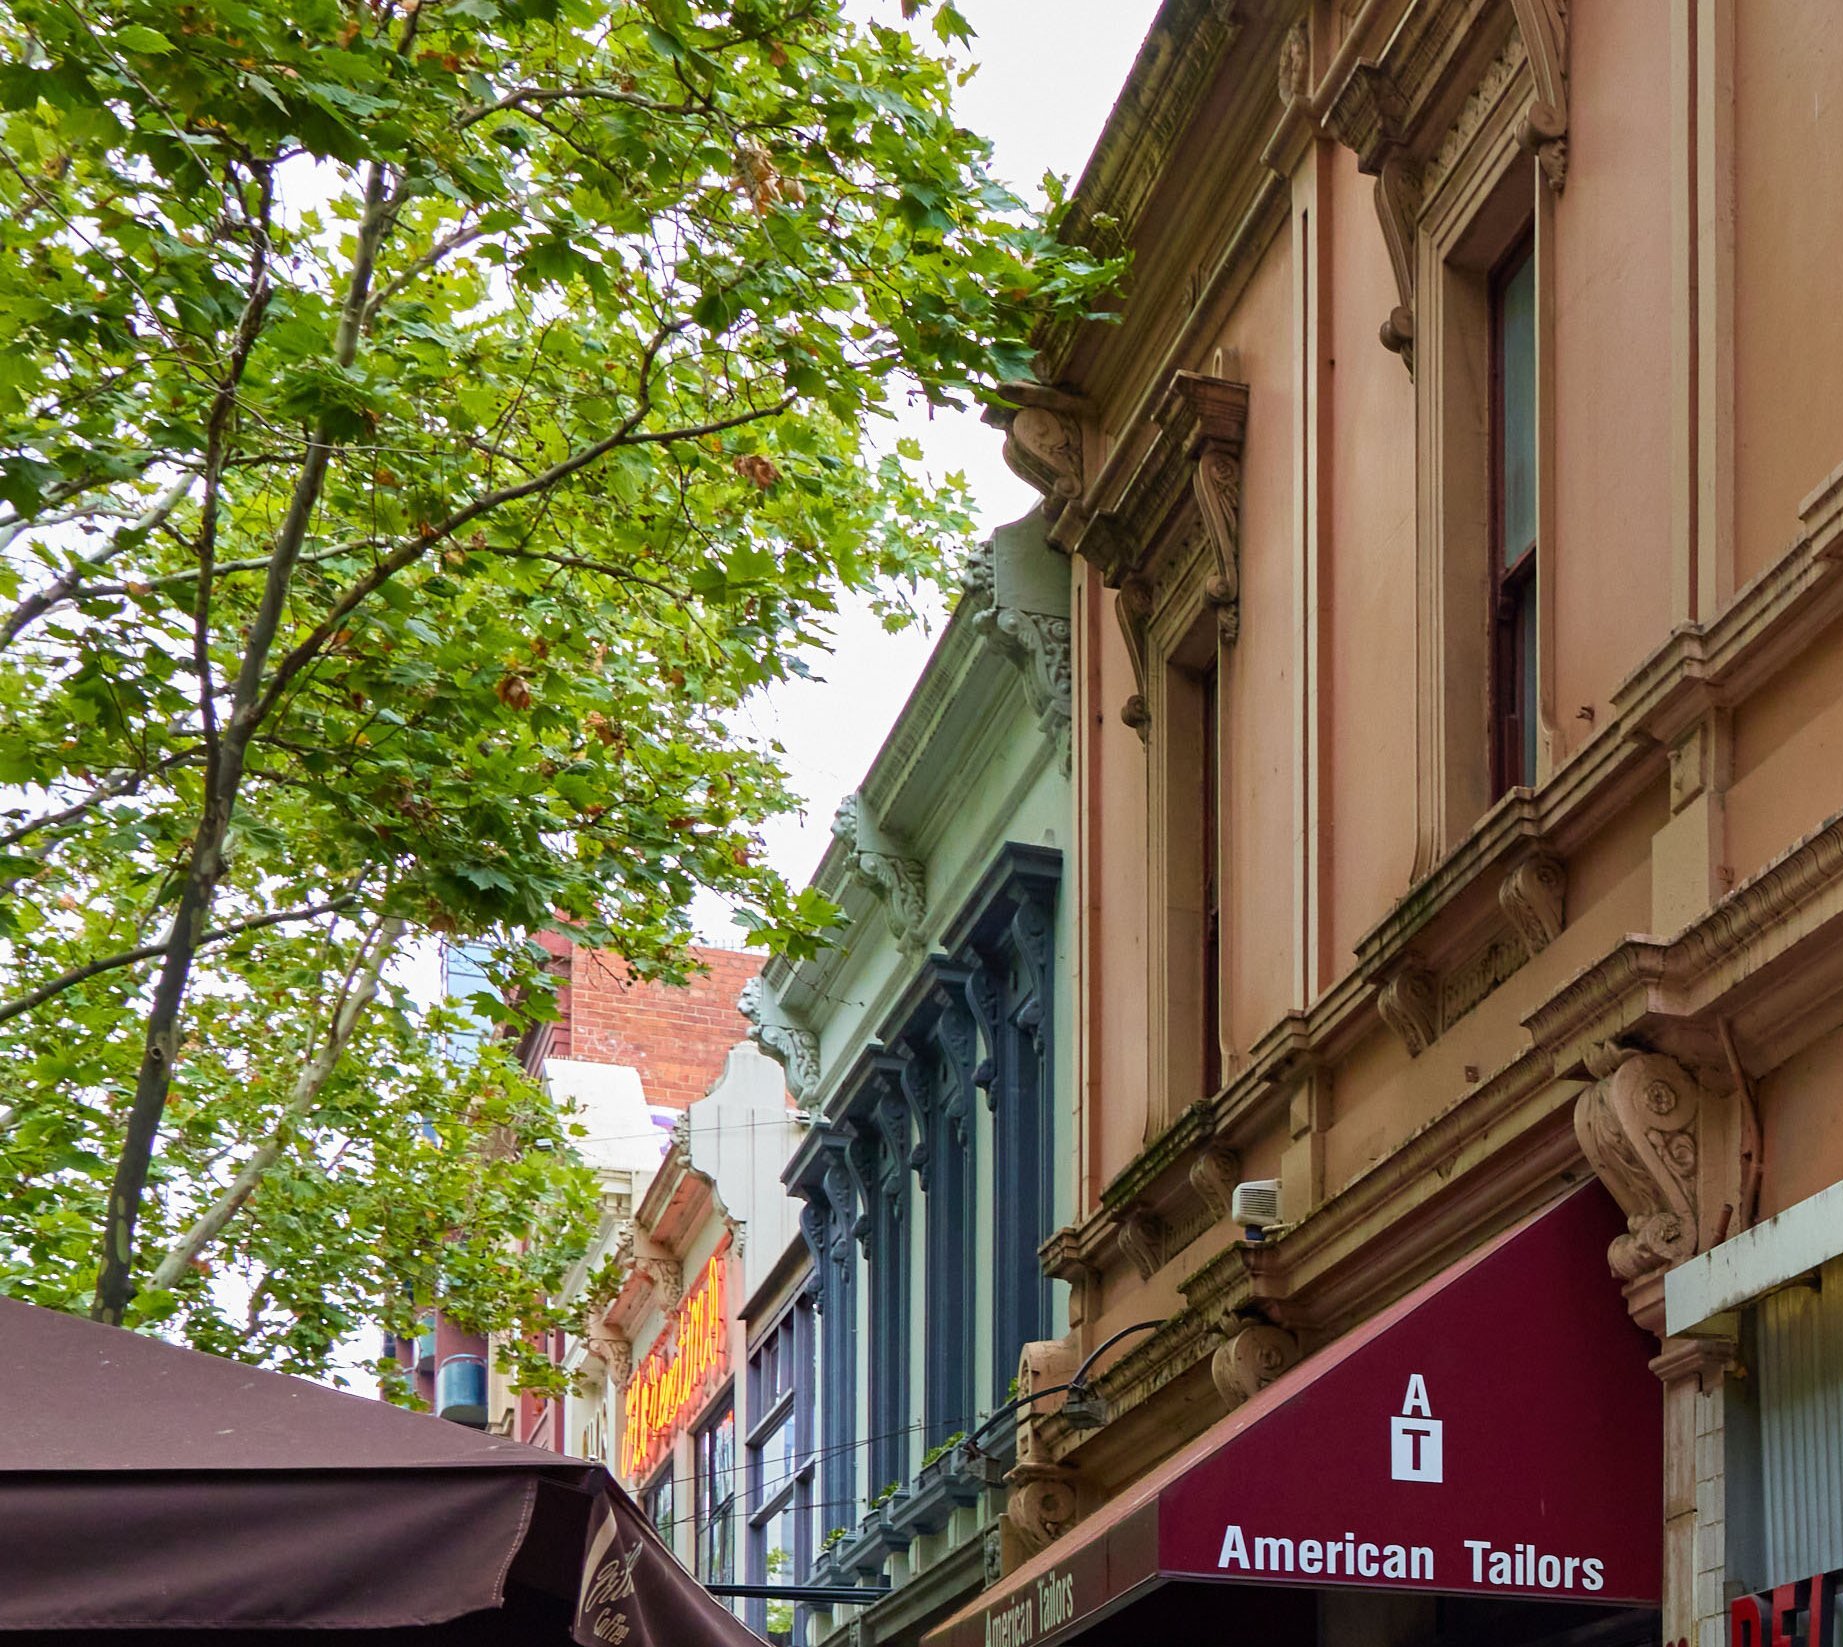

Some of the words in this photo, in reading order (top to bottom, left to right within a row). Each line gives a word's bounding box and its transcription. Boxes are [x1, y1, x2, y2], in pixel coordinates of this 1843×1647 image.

[1401, 1373, 1432, 1417] A
[1217, 1525, 1434, 1581] American
[1463, 1539, 1605, 1592] Tailors
[593, 1606, 630, 1646] Coffee
[1037, 1570, 1074, 1634] Tailors
